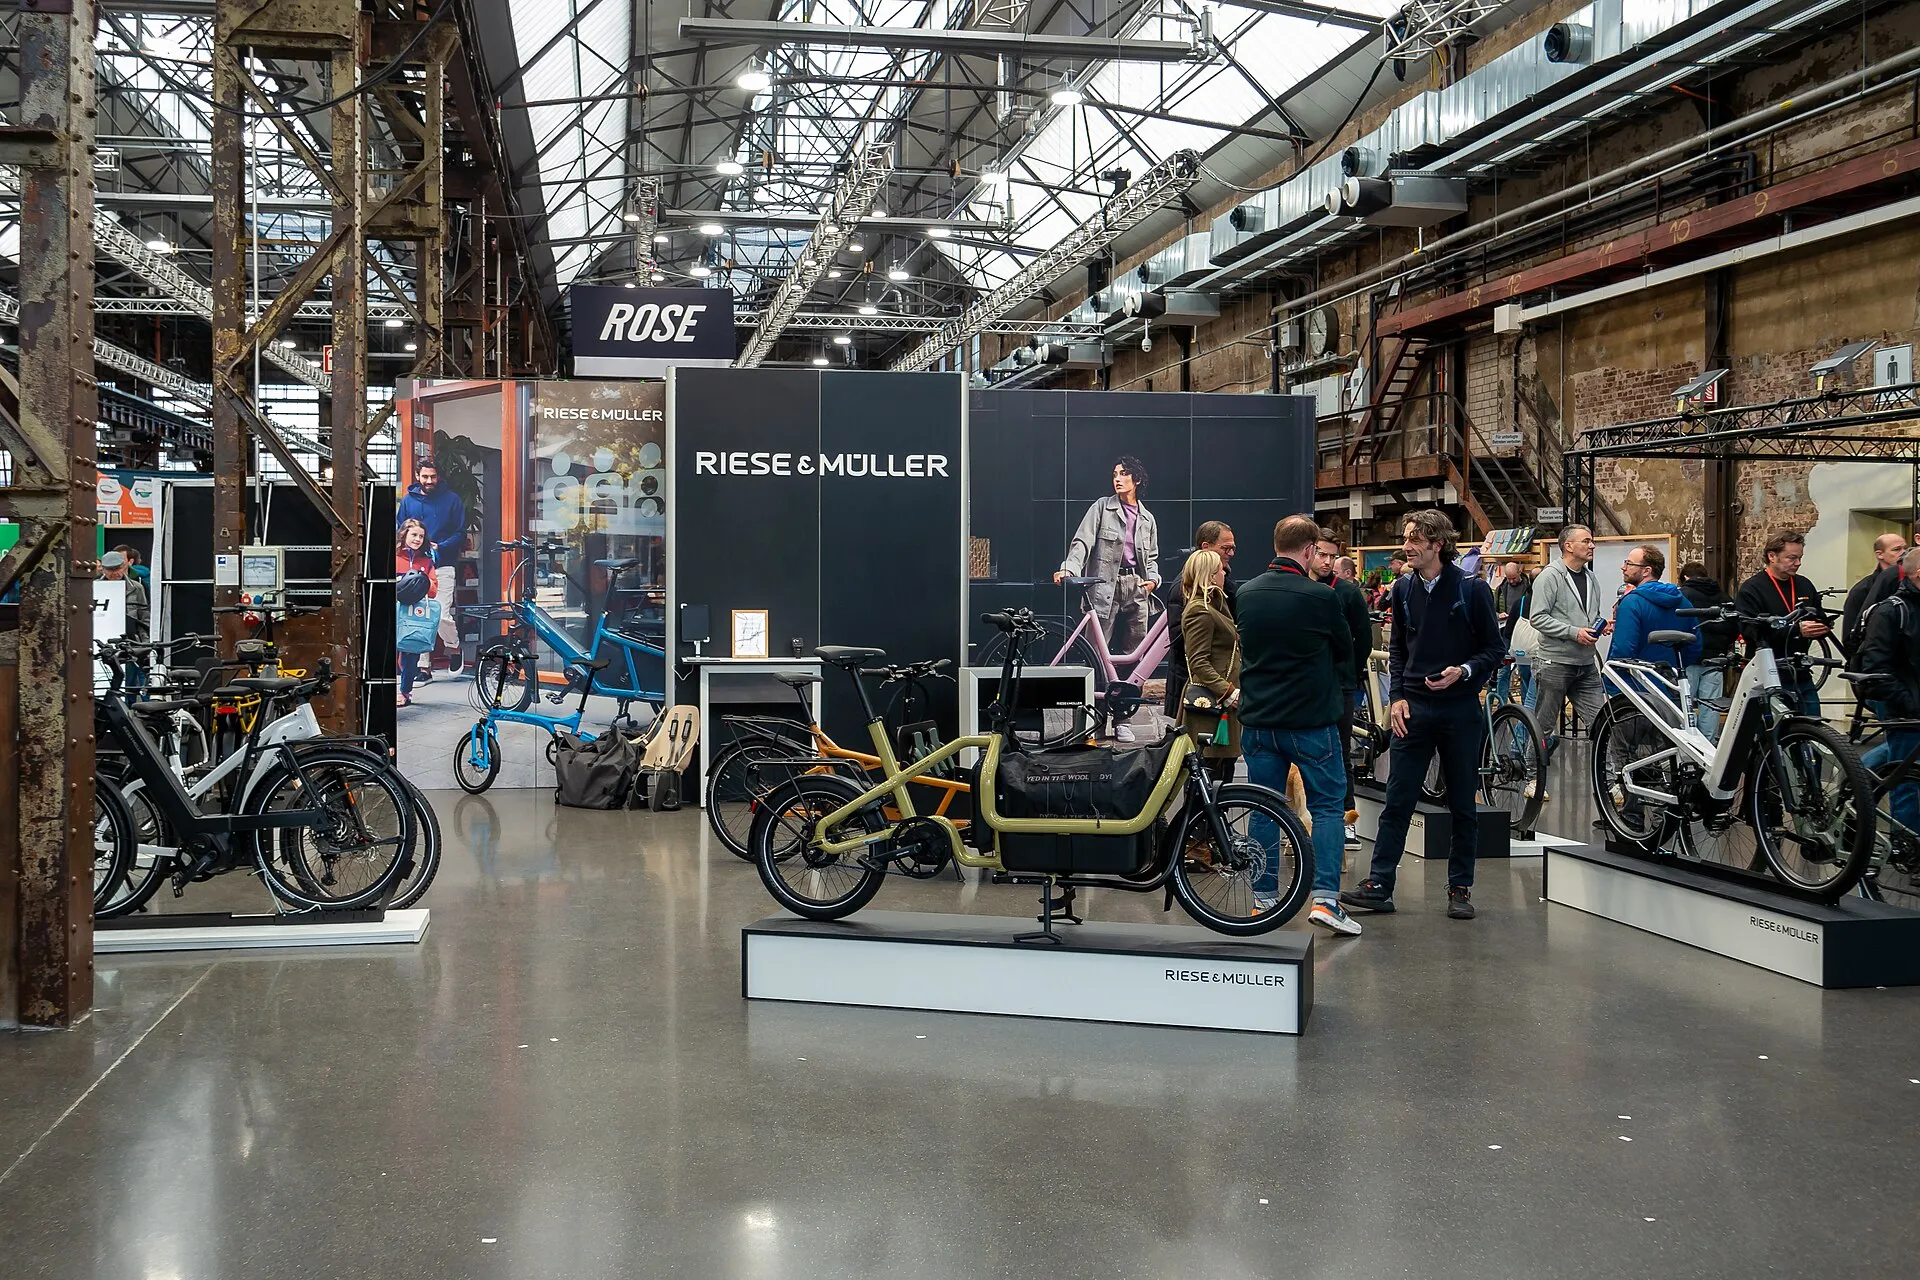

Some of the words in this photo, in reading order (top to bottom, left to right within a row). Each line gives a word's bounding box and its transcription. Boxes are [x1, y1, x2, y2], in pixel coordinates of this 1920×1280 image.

[1754, 192, 1769, 218] 9
[1669, 220, 1690, 244] 10
[1466, 286, 1481, 308] 13
[1507, 274, 1522, 296] 12
[600, 304, 707, 342] ROSE
[544, 408, 589, 419] RIESE
[591, 410, 600, 419] &
[602, 409, 663, 421] MÜLLER
[696, 451, 792, 476] RIESE
[797, 456, 816, 475] &
[819, 454, 949, 477] MÜLLER
[1750, 916, 1775, 931] RIESE
[1782, 925, 1819, 944] MÜLLER
[1165, 970, 1210, 982] RIESE
[1212, 973, 1220, 982] &
[1222, 973, 1285, 987] MÜLLER
